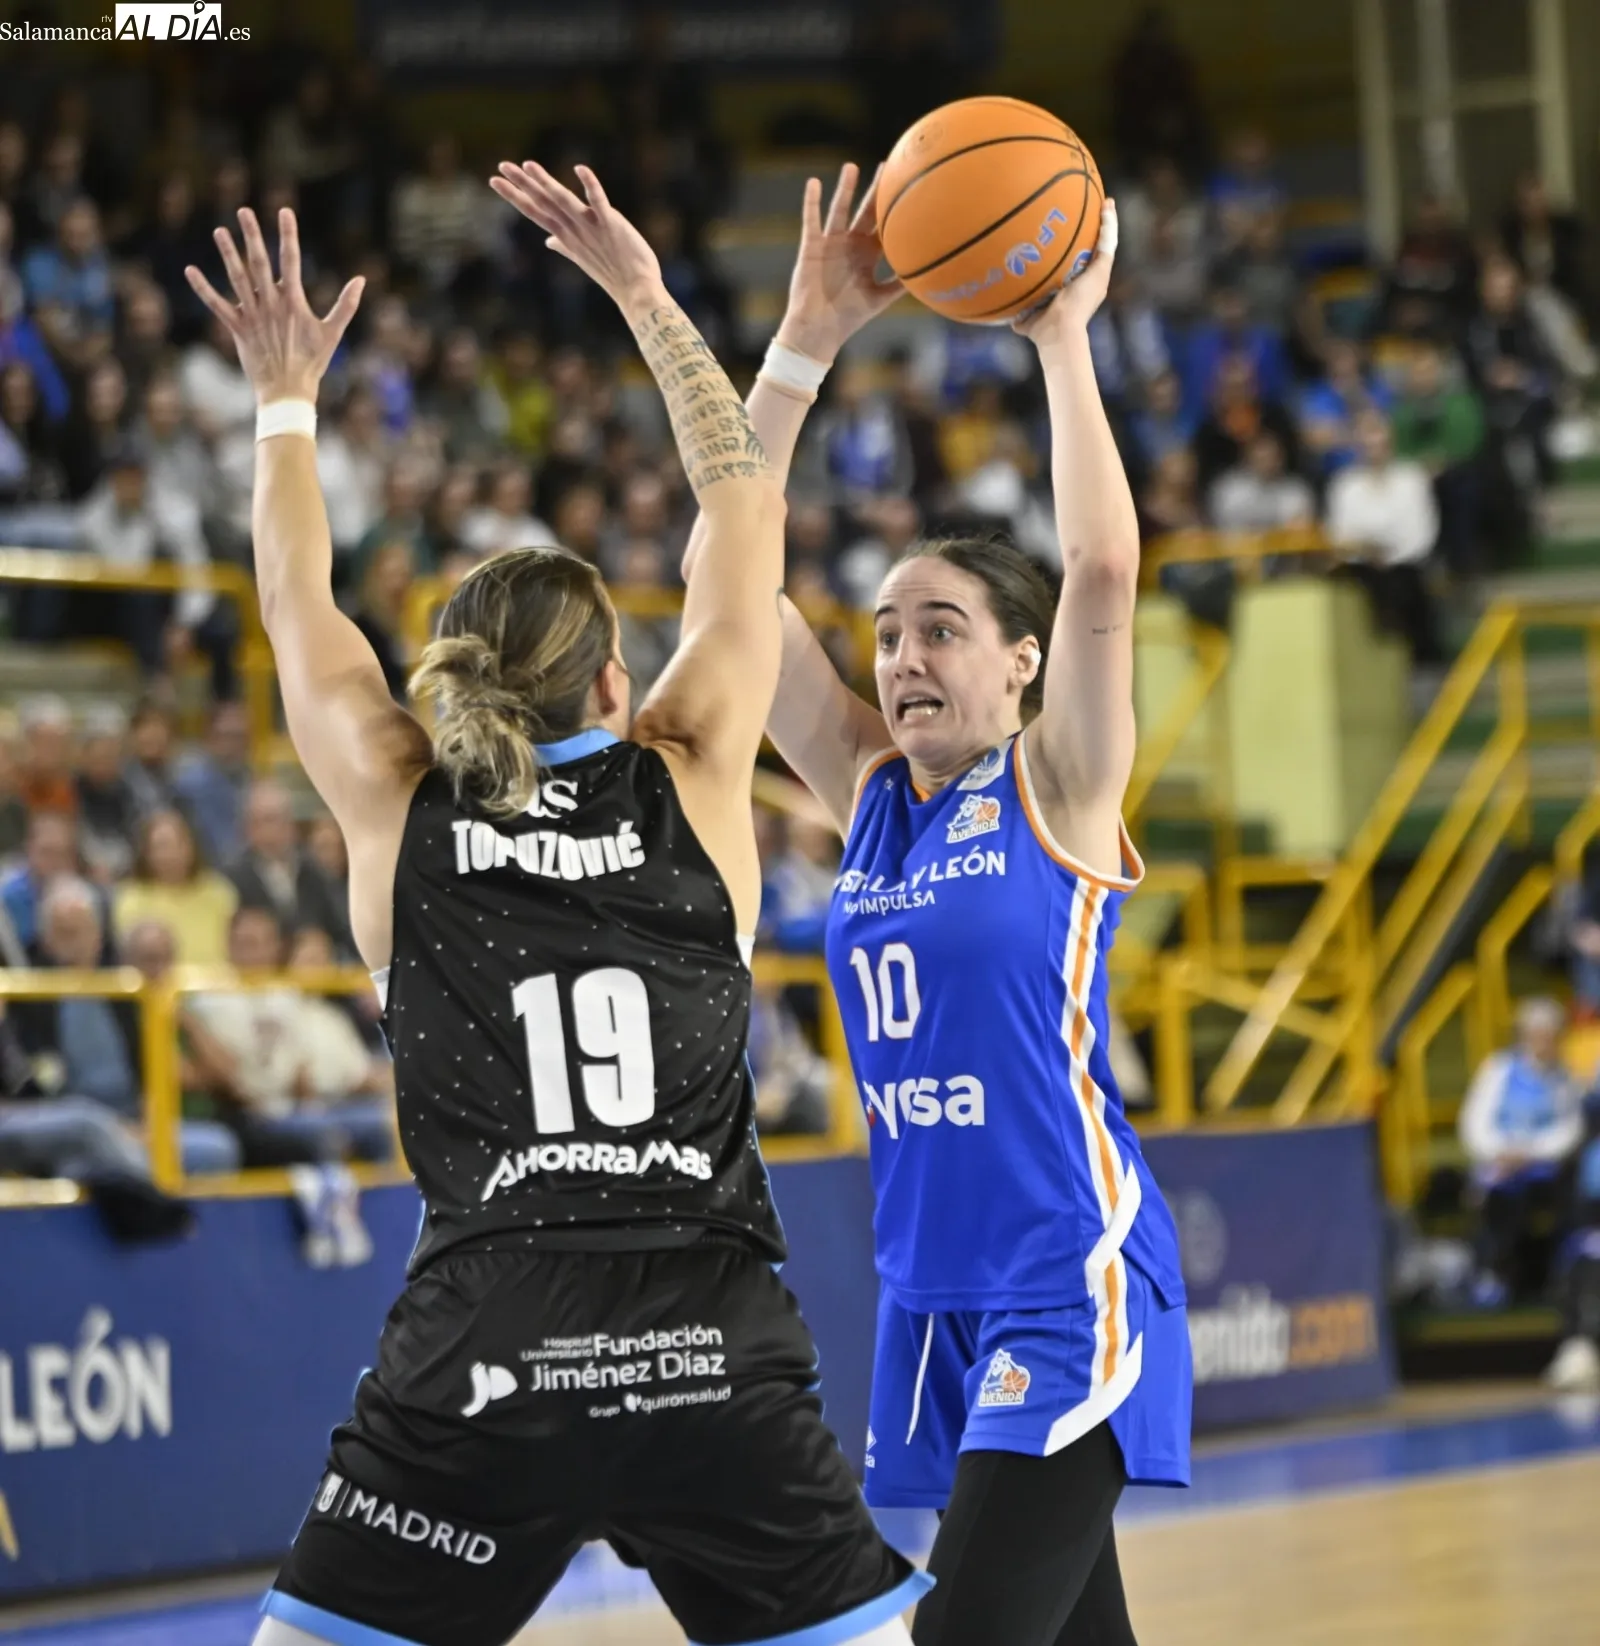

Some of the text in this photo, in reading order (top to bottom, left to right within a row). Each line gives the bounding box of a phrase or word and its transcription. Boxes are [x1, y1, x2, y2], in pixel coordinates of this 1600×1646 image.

[451, 819, 646, 882] TOPUZOVIĆ
[928, 844, 1006, 883] LEÓN
[860, 889, 936, 917] IMPULSA
[850, 942, 922, 1043] 10
[511, 966, 656, 1135] 19
[542, 1325, 724, 1358] Hospital Fundación
[0, 1303, 172, 1453] LEÓN
[530, 1350, 726, 1392] Jiménez Díaz
[588, 1405, 621, 1418] Grupo
[346, 1488, 498, 1565] MADRID
